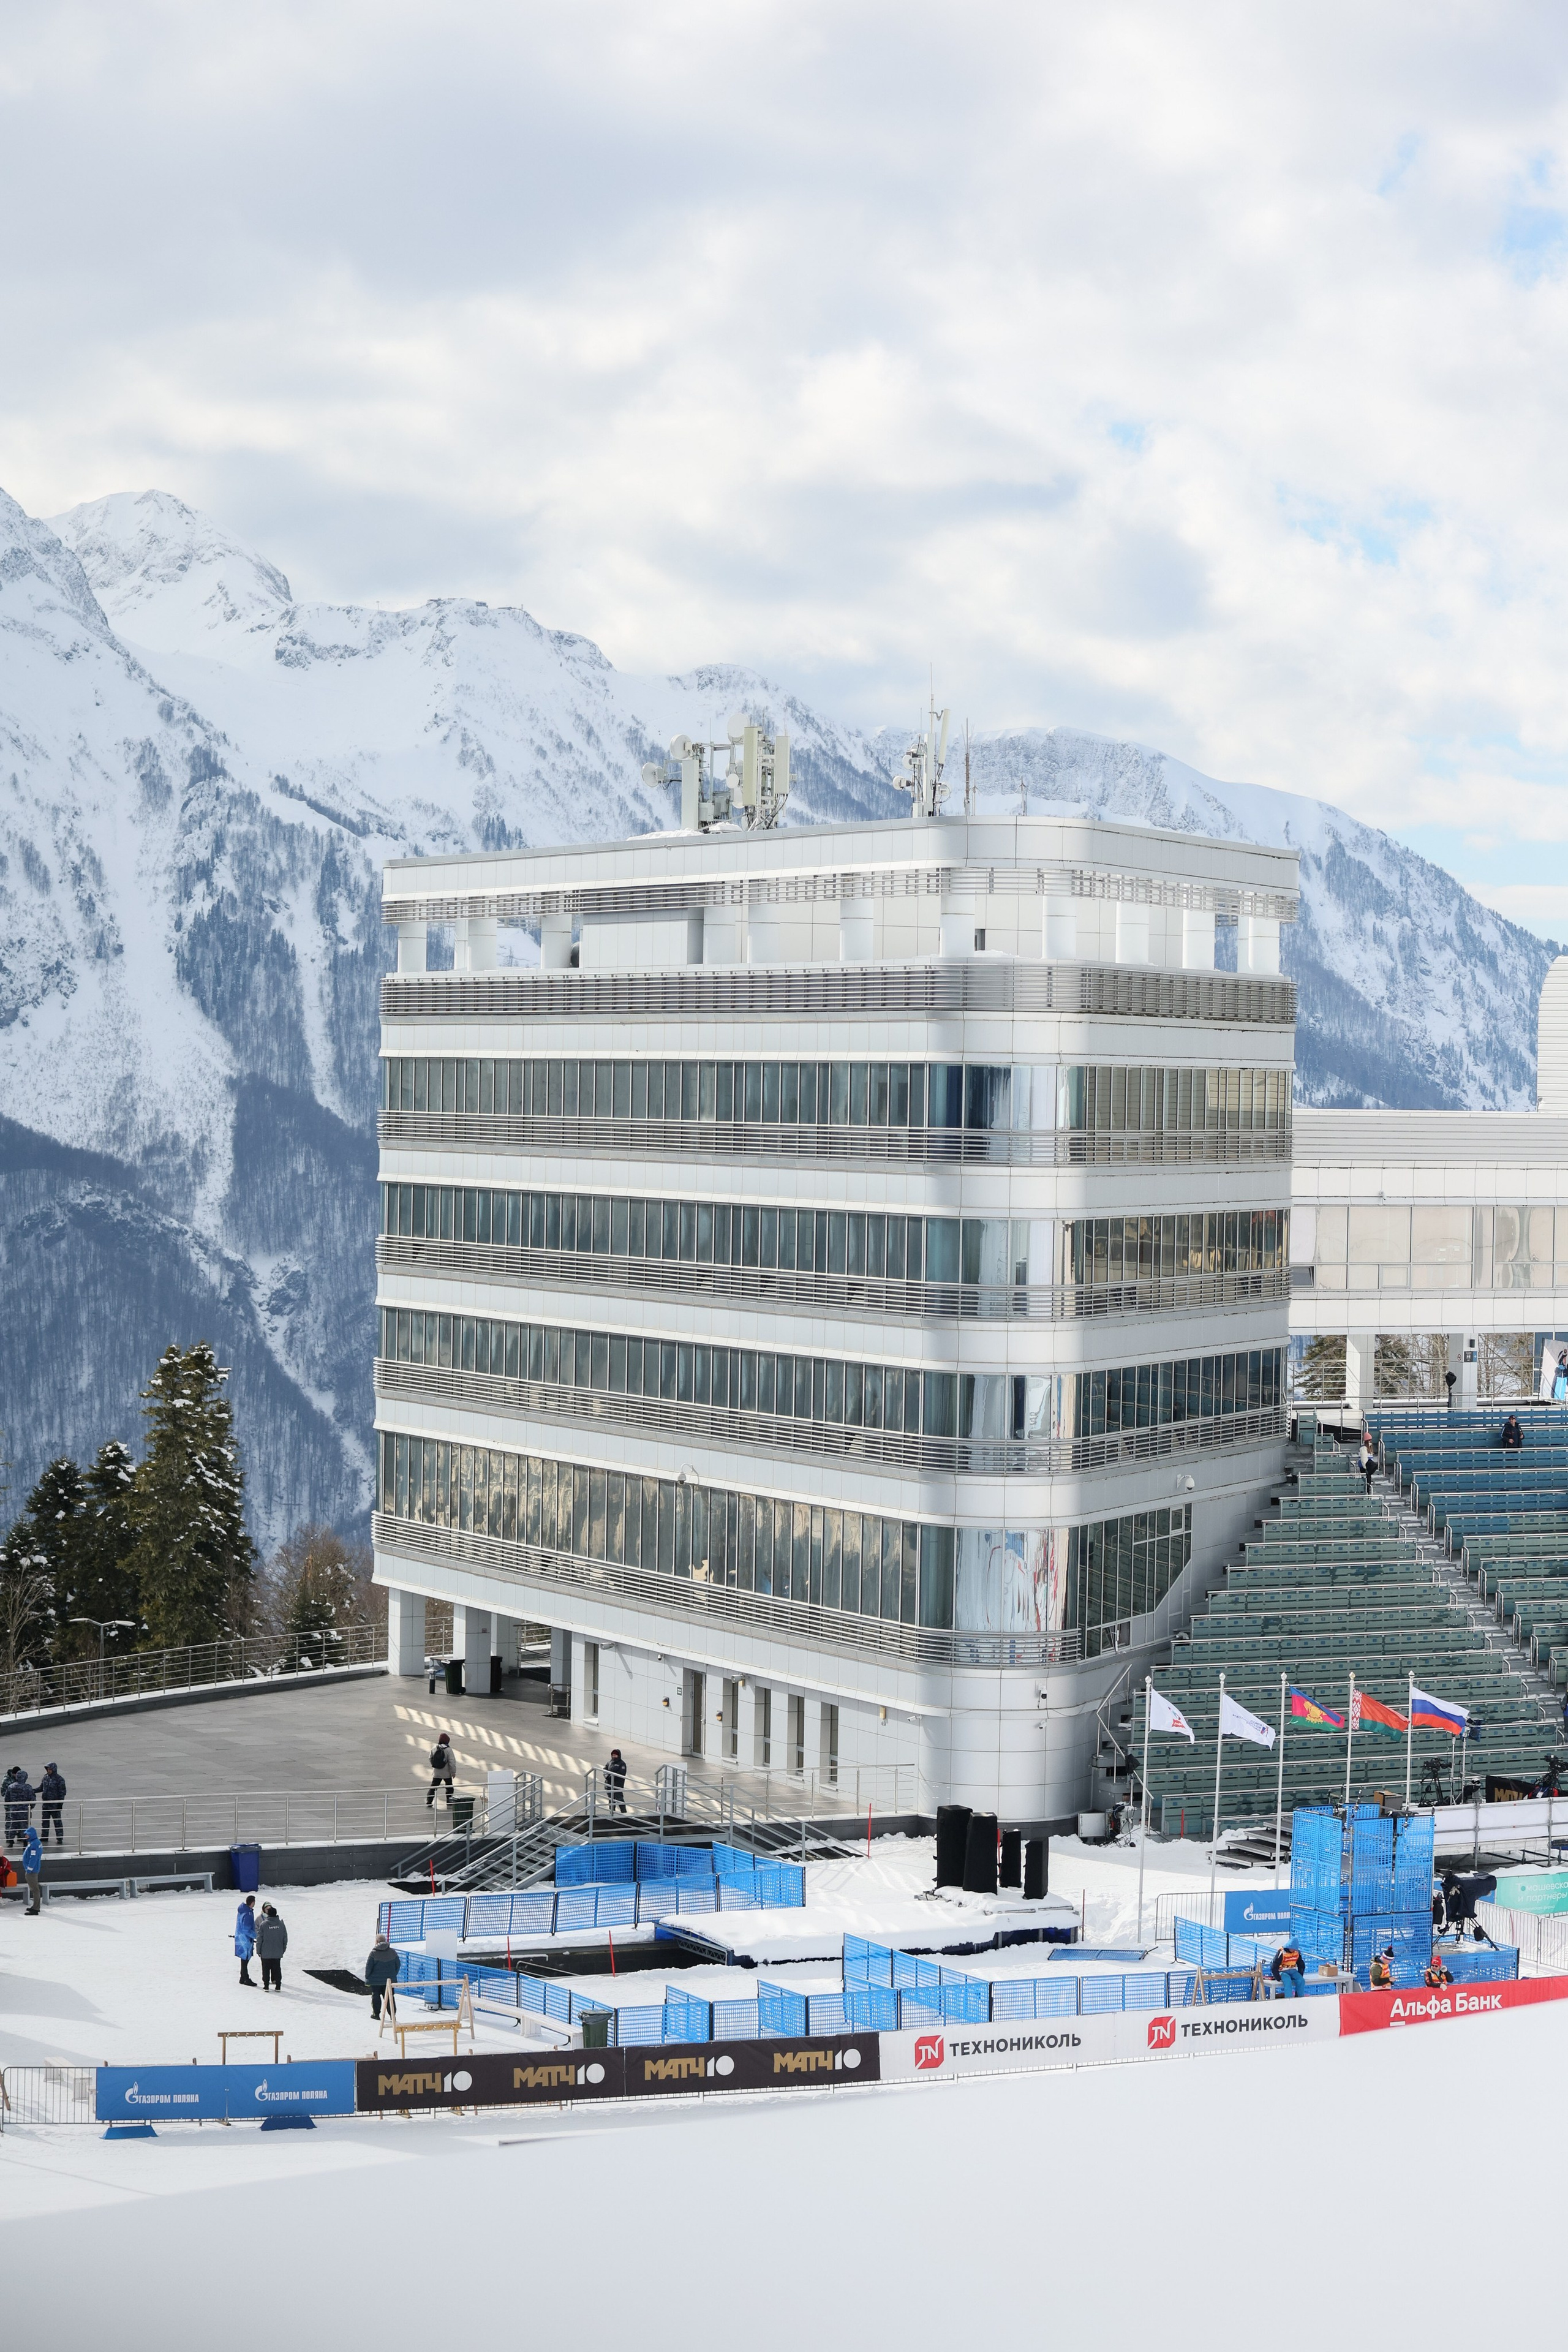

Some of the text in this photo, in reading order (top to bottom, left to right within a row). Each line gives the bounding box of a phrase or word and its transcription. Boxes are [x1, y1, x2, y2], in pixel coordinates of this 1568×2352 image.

[1526, 1891, 1568, 1903] партнёры
[1254, 1912, 1276, 1921] ГАЗПРОМ
[1390, 1992, 1502, 2019] Альфа Банк
[1181, 2015, 1308, 2037] ТЕХНОНИКОЛЬ
[949, 2034, 1082, 2057] ТЕХНОНИКОЛЬ
[138, 2094, 199, 2104] ГАЗПРОМ ПОЛЯНА
[268, 2090, 328, 2101] ГАЗПРОМ ПОЛЯНА
